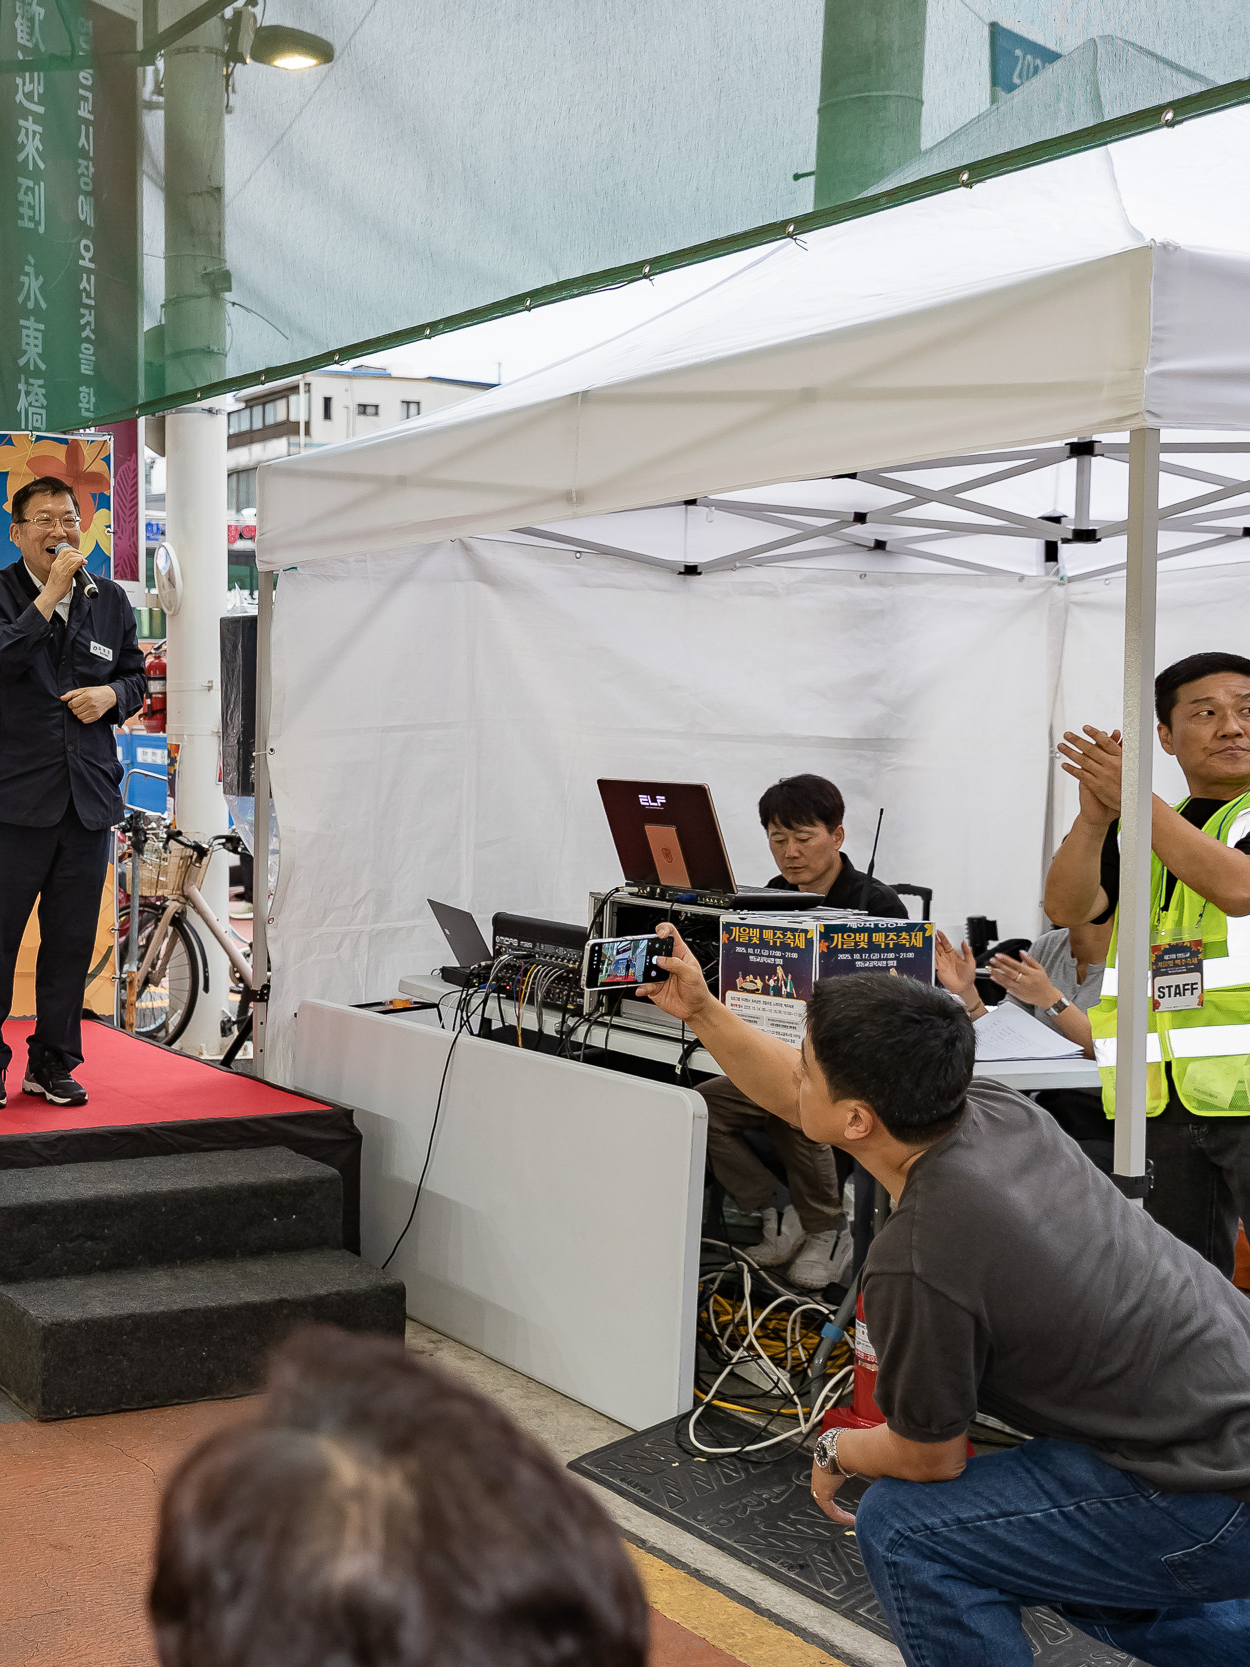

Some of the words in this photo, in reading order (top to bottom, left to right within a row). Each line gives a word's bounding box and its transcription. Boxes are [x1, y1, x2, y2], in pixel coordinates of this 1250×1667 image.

[77, 239, 96, 378] 오신것을
[16, 255, 48, 431] 永東橋
[638, 794, 666, 806] ELF
[730, 927, 759, 944] 가을빛
[763, 929, 805, 949] 맥주축제
[830, 933, 868, 949] 가을빛
[872, 932, 922, 949] 맥주축제
[1158, 982, 1198, 999] STAFF
